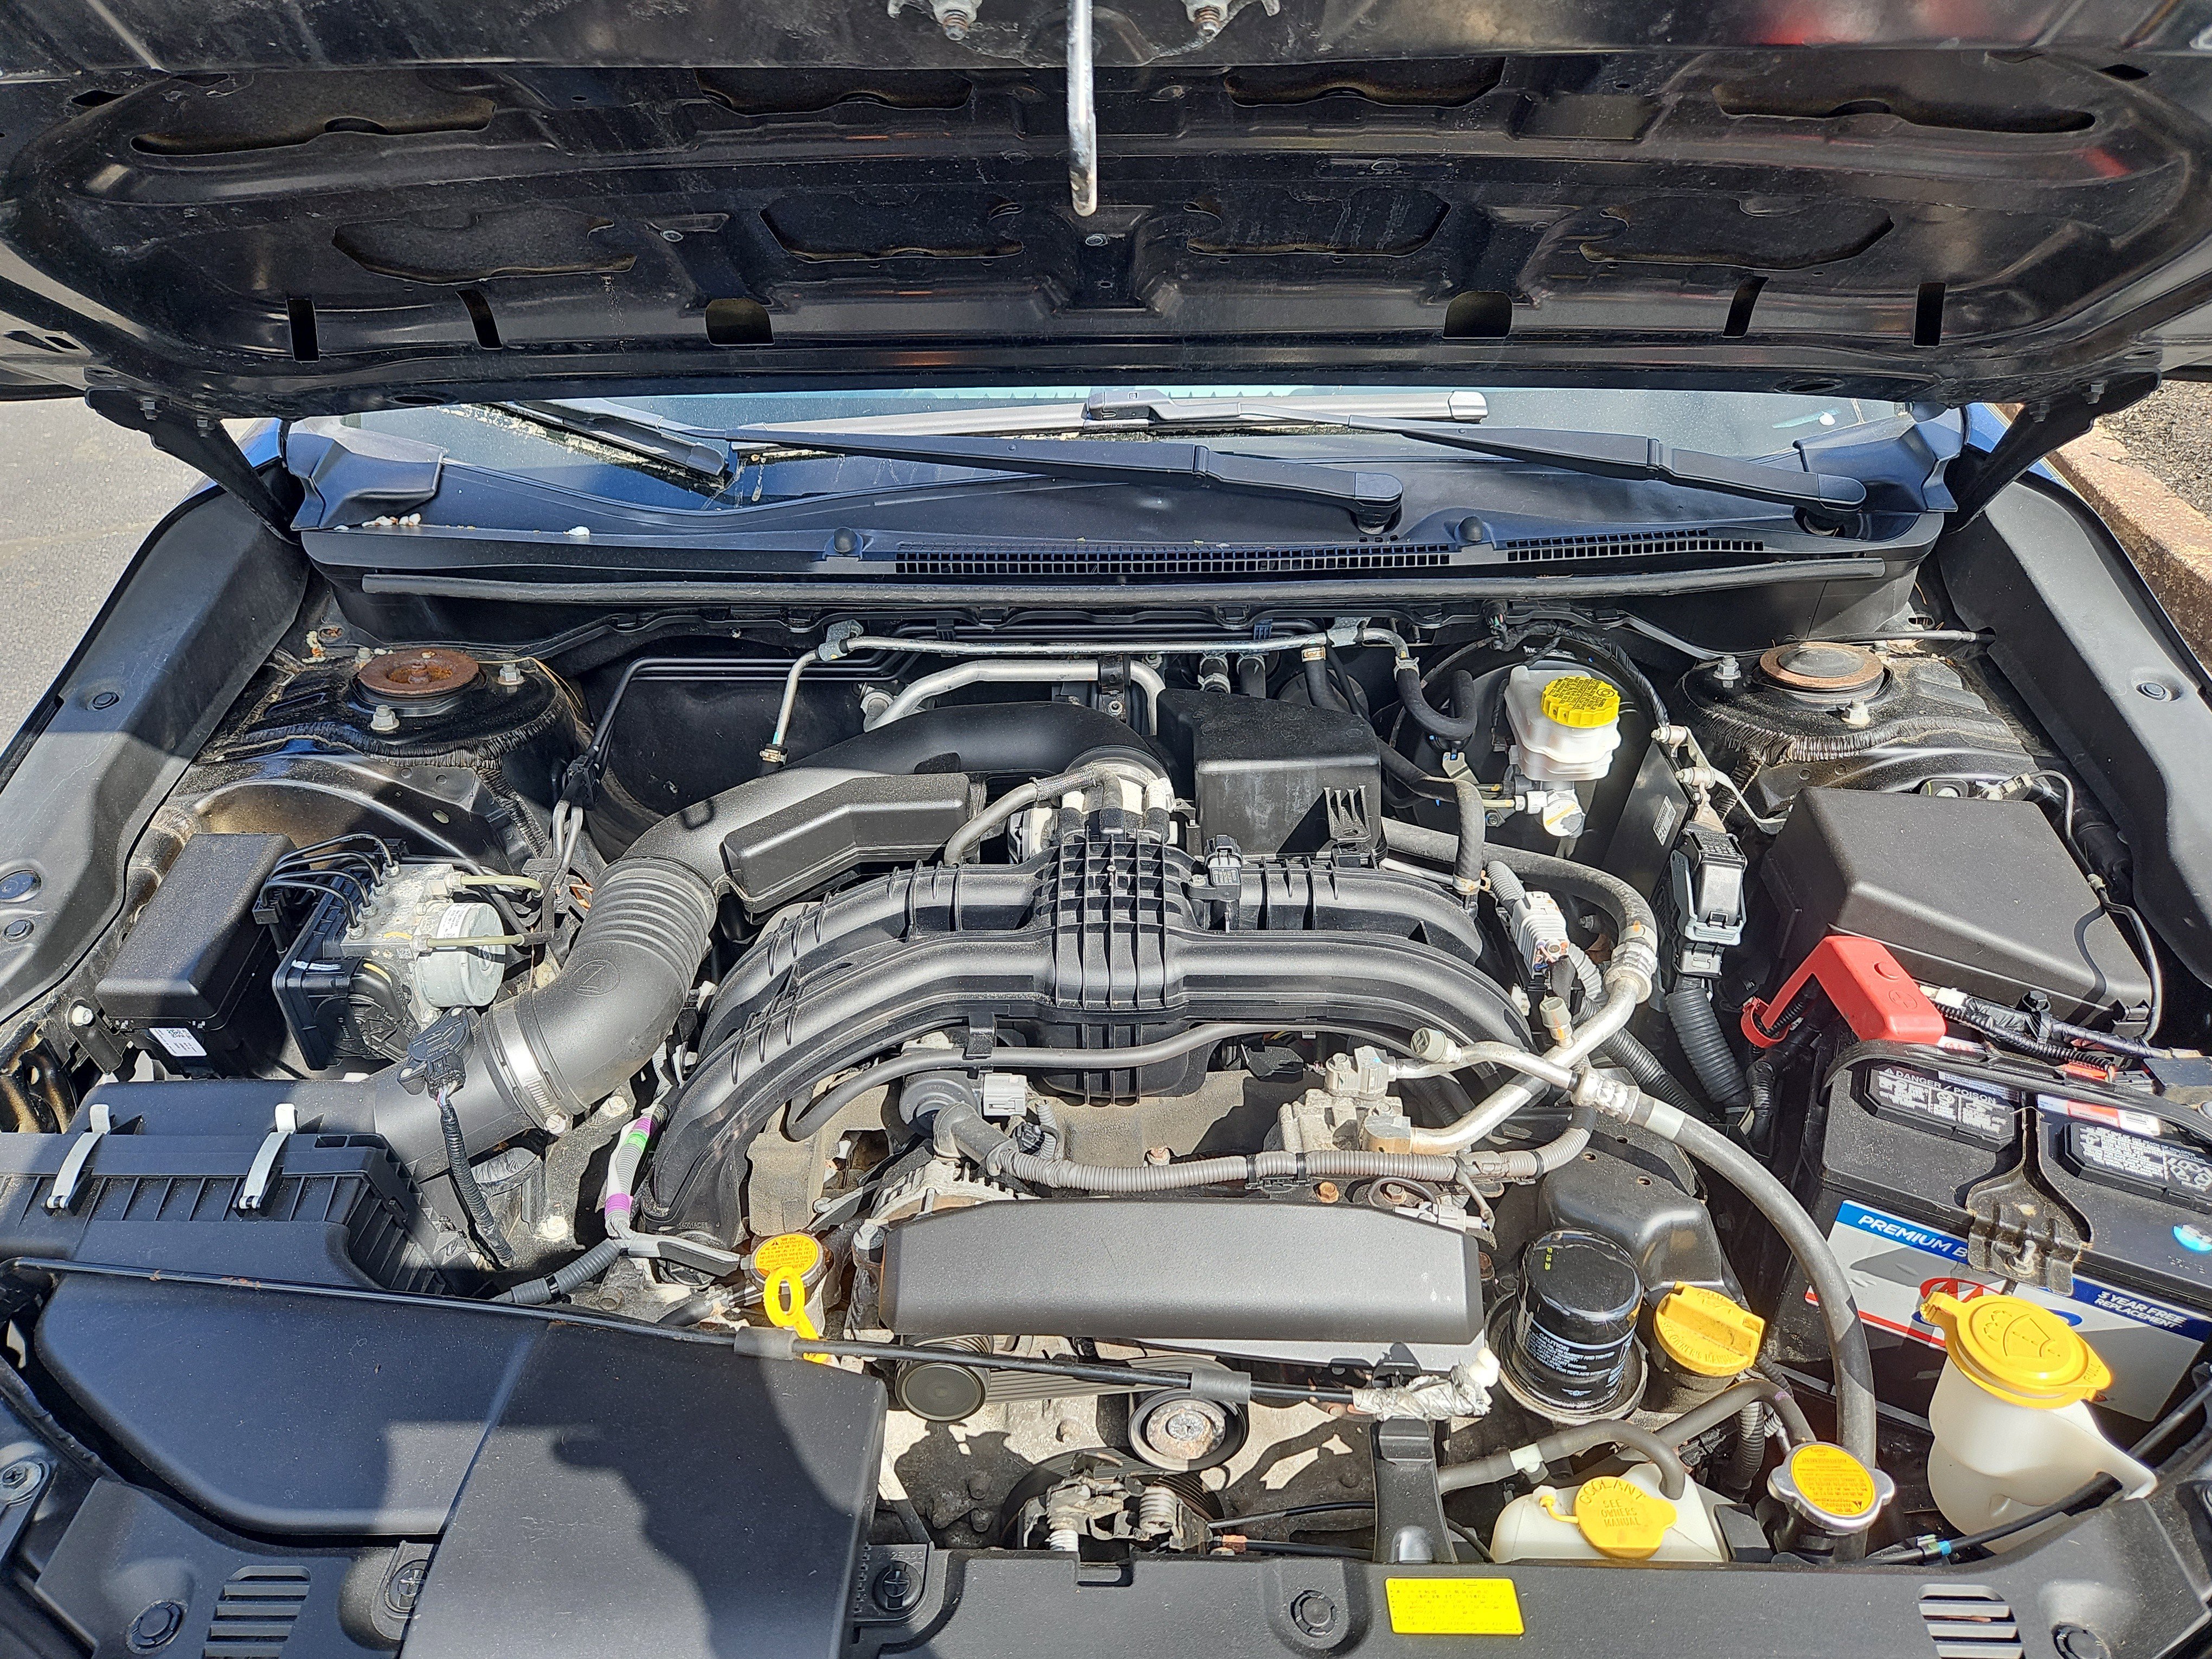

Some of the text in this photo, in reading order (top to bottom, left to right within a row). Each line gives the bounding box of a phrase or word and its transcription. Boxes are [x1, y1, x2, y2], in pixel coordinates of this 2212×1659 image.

[1895, 1068, 1941, 1089] DANGER
[1954, 1086, 1997, 1105] POISON
[1858, 1215, 1953, 1252] PREMIUM
[2094, 1298, 2184, 1328] REPLACEMENT
[2097, 1291, 2188, 1323] 3 YEAR FREE
[1539, 1333, 1570, 1352] CAUTION
[1579, 1479, 1647, 1505] COOLANT
[1603, 1500, 1622, 1508] SEE
[1601, 1507, 1637, 1517] OWNERS
[1603, 1517, 1642, 1527] MANUAL
